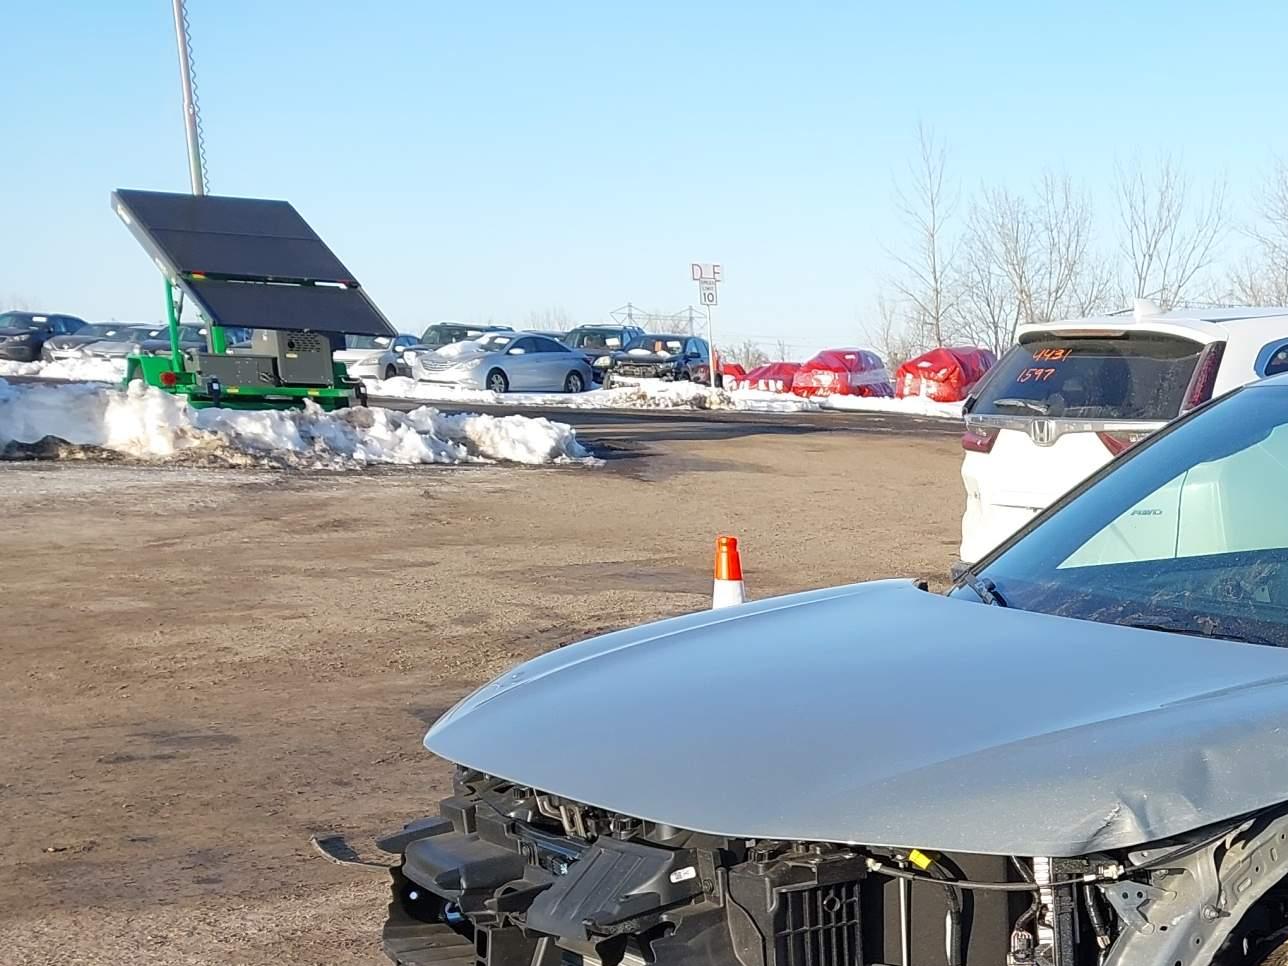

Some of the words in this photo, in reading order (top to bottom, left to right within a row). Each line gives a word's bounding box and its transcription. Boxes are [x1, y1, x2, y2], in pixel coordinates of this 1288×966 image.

[703, 292, 715, 302] 10
[1016, 367, 1056, 383] 1597
[1131, 508, 1163, 516] AWD
